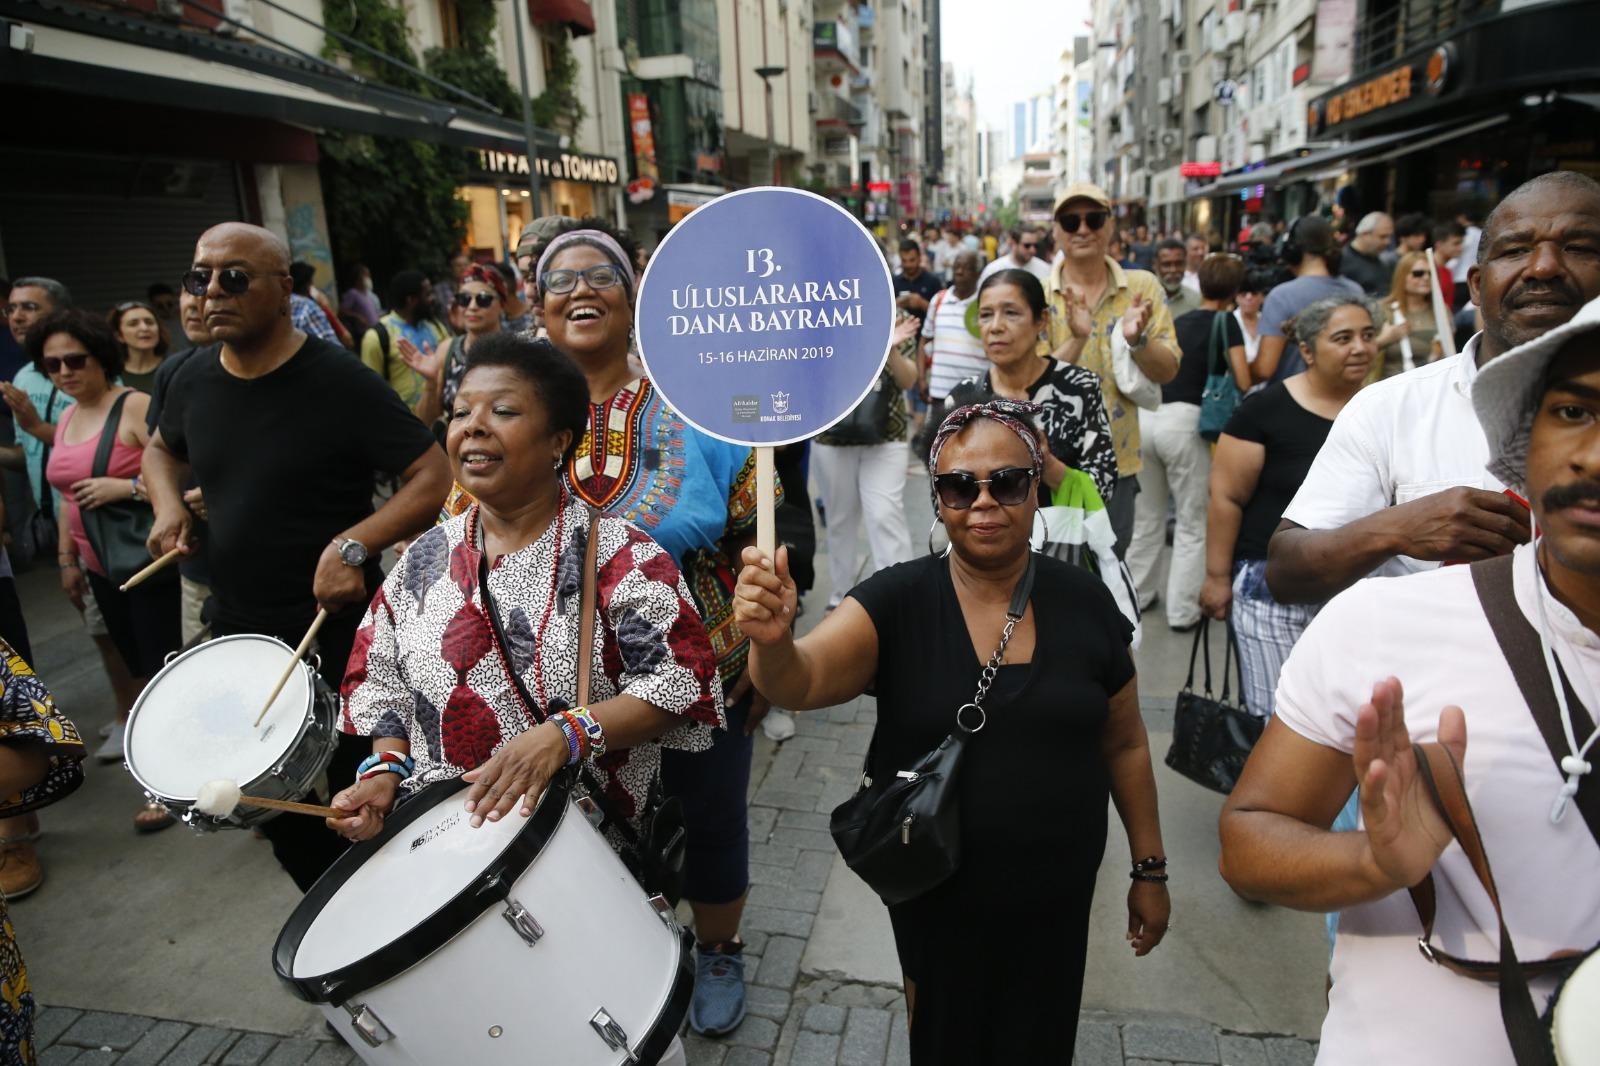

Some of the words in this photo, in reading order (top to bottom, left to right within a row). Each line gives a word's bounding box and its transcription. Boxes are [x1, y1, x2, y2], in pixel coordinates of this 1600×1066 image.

[560, 153, 618, 184] TOMATO
[746, 248, 782, 278] 13.
[671, 278, 861, 309] ULUSLARARASI
[667, 313, 744, 336] DANA
[748, 304, 864, 332] BAYRAMI
[699, 351, 735, 364] 15-16
[737, 347, 798, 363] HAZİRAN
[801, 346, 834, 361] 2019
